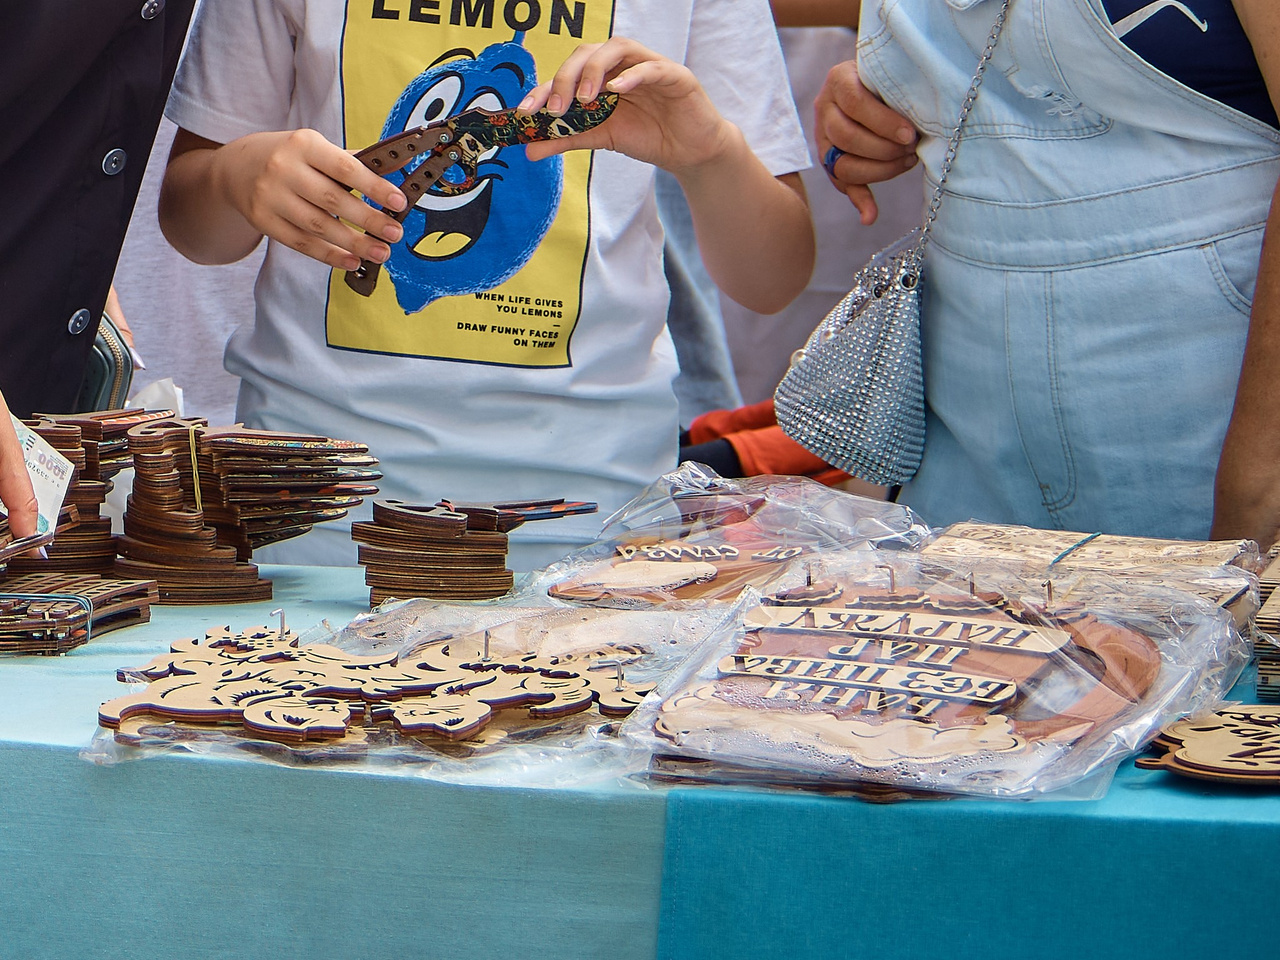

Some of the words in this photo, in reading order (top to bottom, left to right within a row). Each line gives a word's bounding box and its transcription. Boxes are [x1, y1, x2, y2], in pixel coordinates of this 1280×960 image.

[474, 292, 505, 302] WHEN
[508, 295, 531, 305] LIFE
[534, 298, 563, 308] GIVES
[496, 304, 518, 314] YOU
[521, 307, 563, 319] LEMONS
[457, 322, 487, 332] DRAW
[491, 326, 526, 336] FUNNY
[529, 329, 559, 339] FACES
[513, 338, 528, 347] ON
[532, 340, 556, 348] THEM
[778, 606, 1038, 648] НАРУЖУ
[828, 638, 969, 670] ПАР
